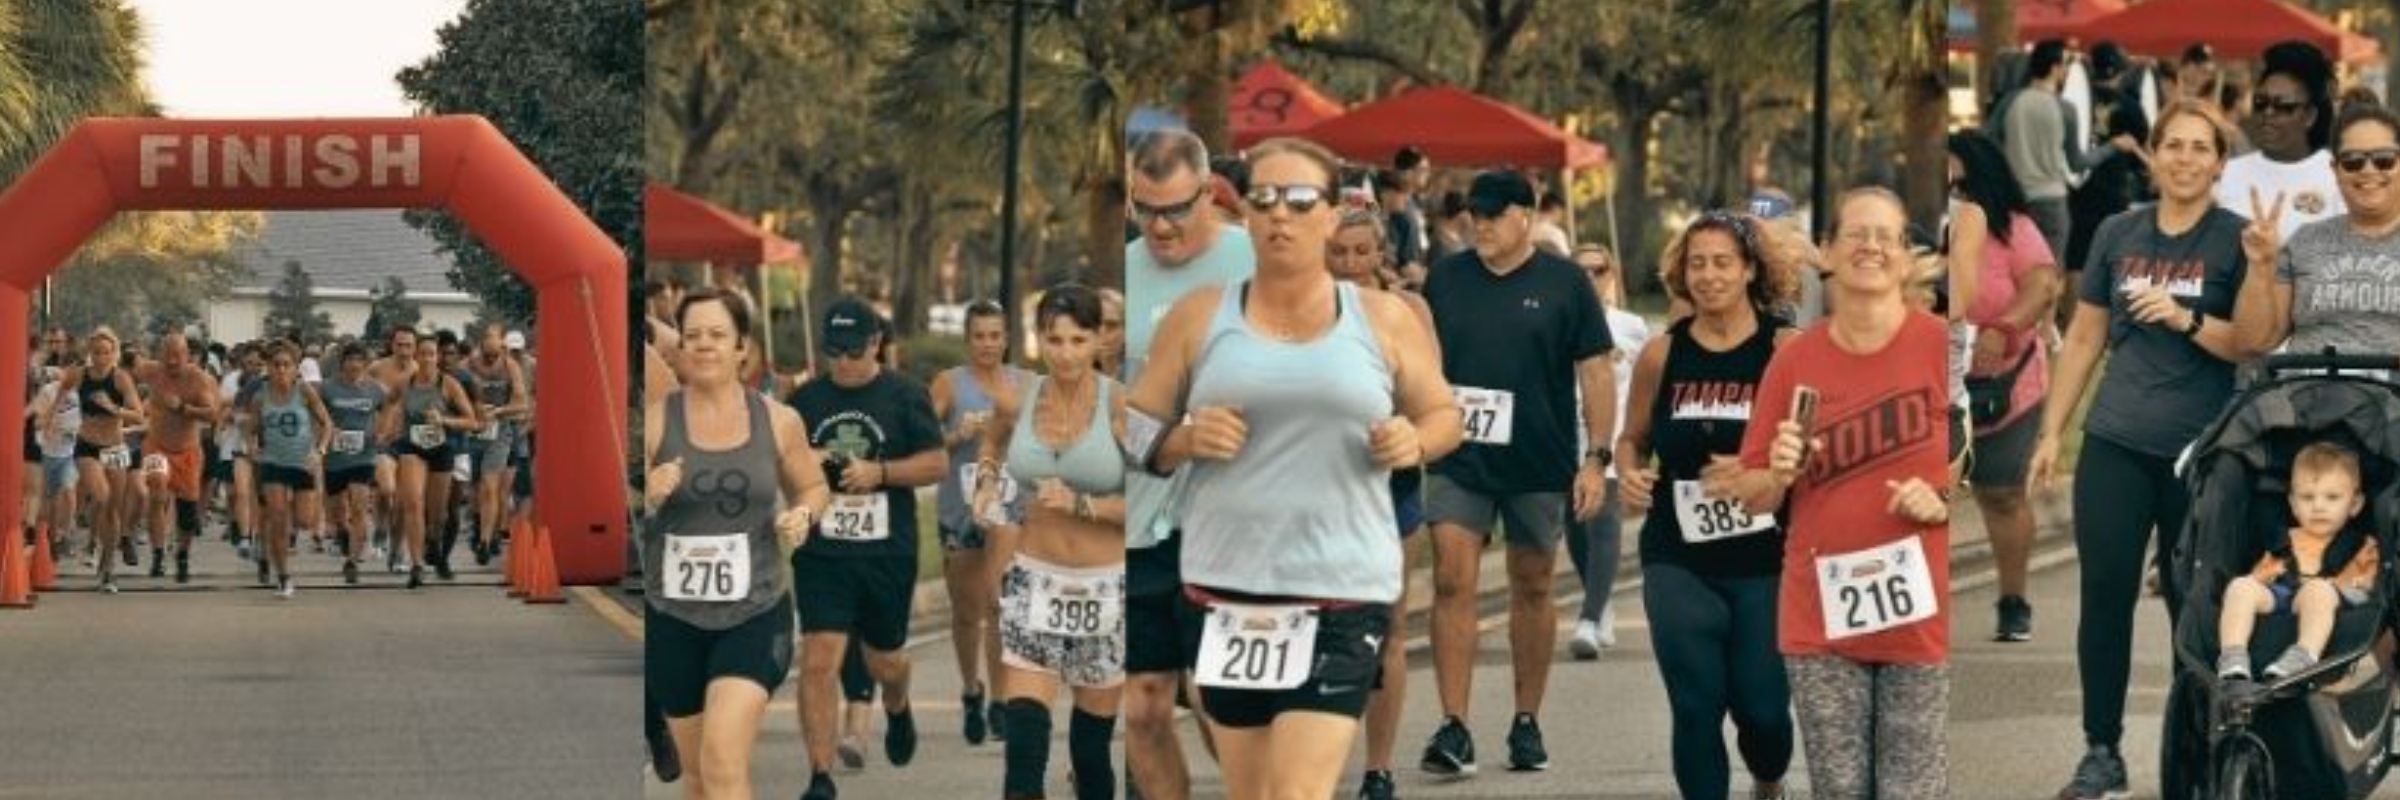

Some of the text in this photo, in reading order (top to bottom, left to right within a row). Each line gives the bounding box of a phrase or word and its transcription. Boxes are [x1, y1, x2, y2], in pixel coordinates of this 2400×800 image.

[139, 134, 420, 188] FINISH
[1672, 381, 1754, 411] TAMPA
[834, 511, 875, 538] 324
[679, 559, 734, 596] 276
[1049, 598, 1101, 632] 398
[1839, 573, 1914, 628] 216
[1221, 635, 1291, 682] 201
